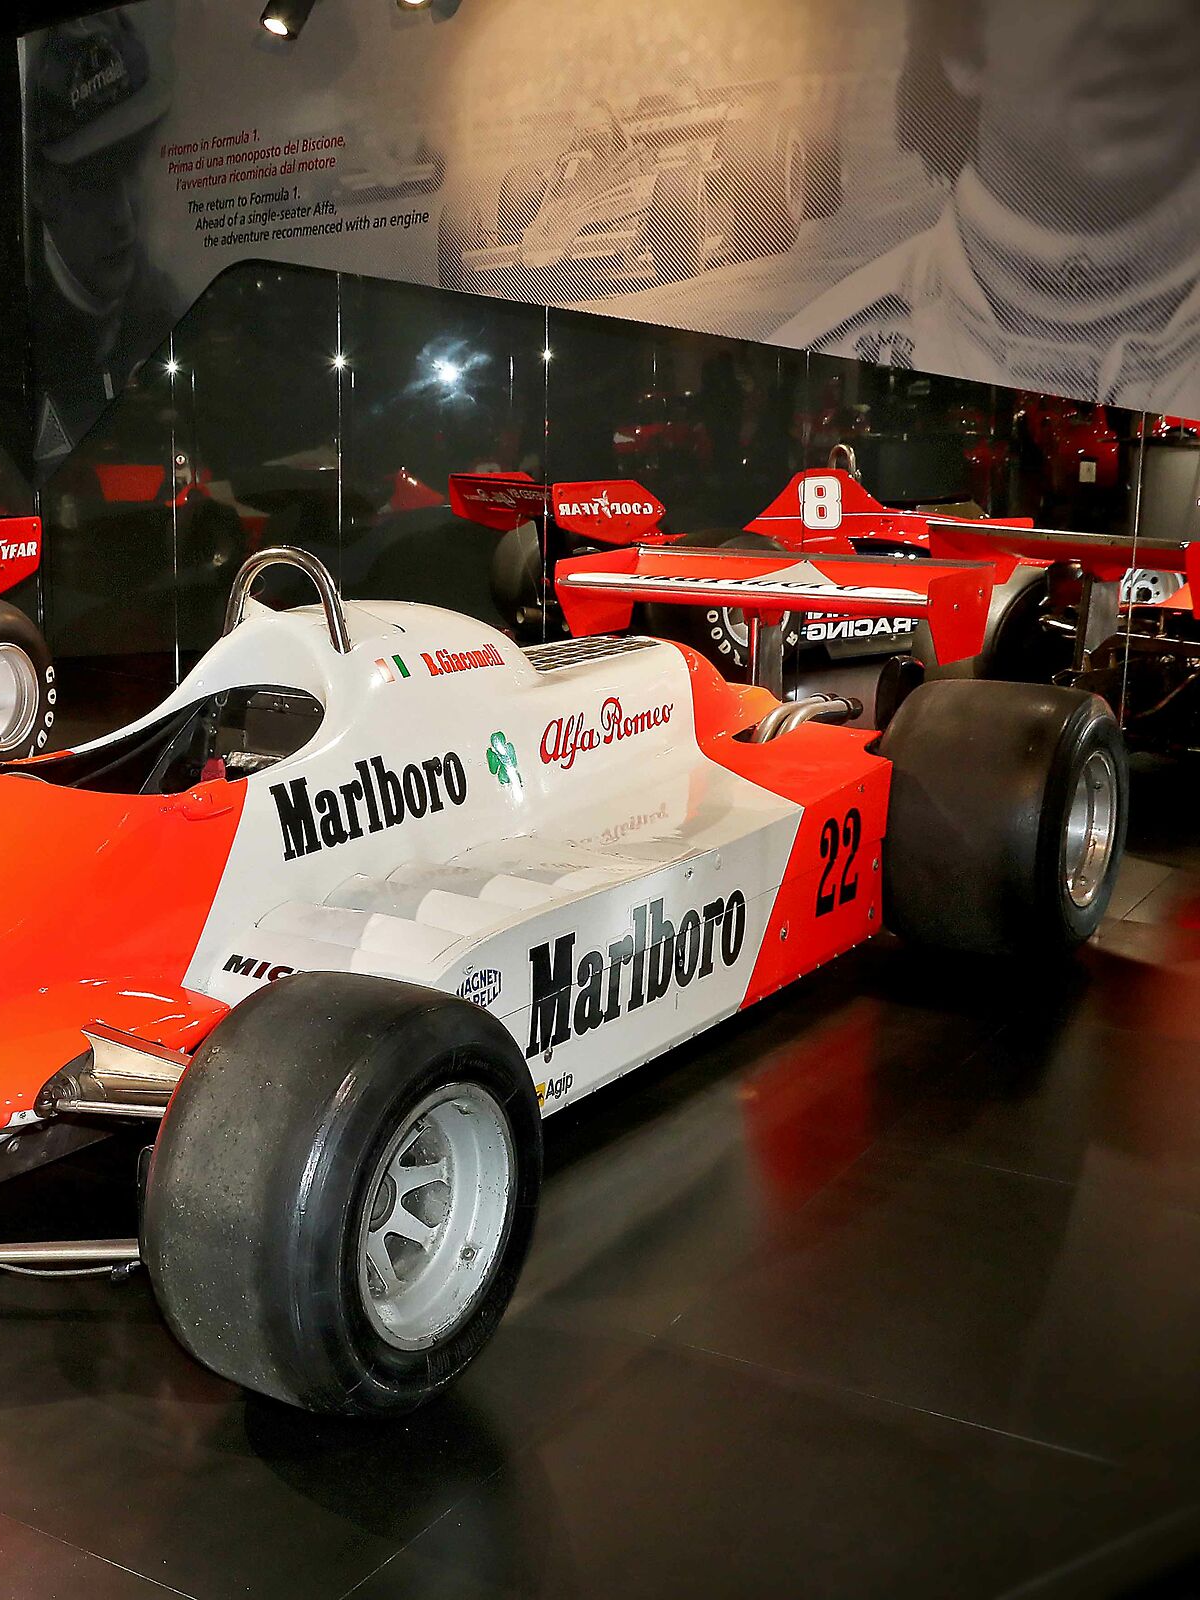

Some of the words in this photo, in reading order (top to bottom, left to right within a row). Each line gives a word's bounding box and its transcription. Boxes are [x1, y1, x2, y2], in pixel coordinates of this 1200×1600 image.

[168, 143, 199, 157] ritorno
[200, 138, 209, 150] in
[211, 131, 250, 149] Formula
[252, 129, 260, 142] 1.
[168, 160, 193, 174] Prima
[195, 156, 204, 170] di
[206, 157, 224, 169] una
[226, 147, 281, 165] monoposto
[284, 140, 299, 156] del
[302, 135, 346, 152] Biscione,
[229, 163, 277, 183] ricomincia
[280, 159, 295, 175] dal
[298, 156, 336, 173] motore
[187, 200, 204, 214] The
[206, 198, 235, 211] return
[237, 195, 247, 207] to
[250, 187, 289, 205] Formula
[293, 185, 301, 199] 1.
[195, 214, 225, 231] Ahead
[227, 212, 238, 227] of
[240, 217, 246, 226] a
[248, 205, 311, 226] single-seater
[313, 201, 337, 217] Alfa,
[203, 235, 219, 248] the
[221, 230, 270, 245] adventure
[272, 218, 343, 240] recommenced
[345, 215, 370, 232] with
[373, 217, 387, 229] an
[390, 210, 430, 229] engine
[540, 712, 600, 769] Alfa
[600, 697, 674, 745] Romeo
[269, 752, 467, 861] Marlboro
[815, 808, 861, 917] 22
[525, 889, 746, 1058] Marlboro
[545, 1071, 573, 1100] Agip
